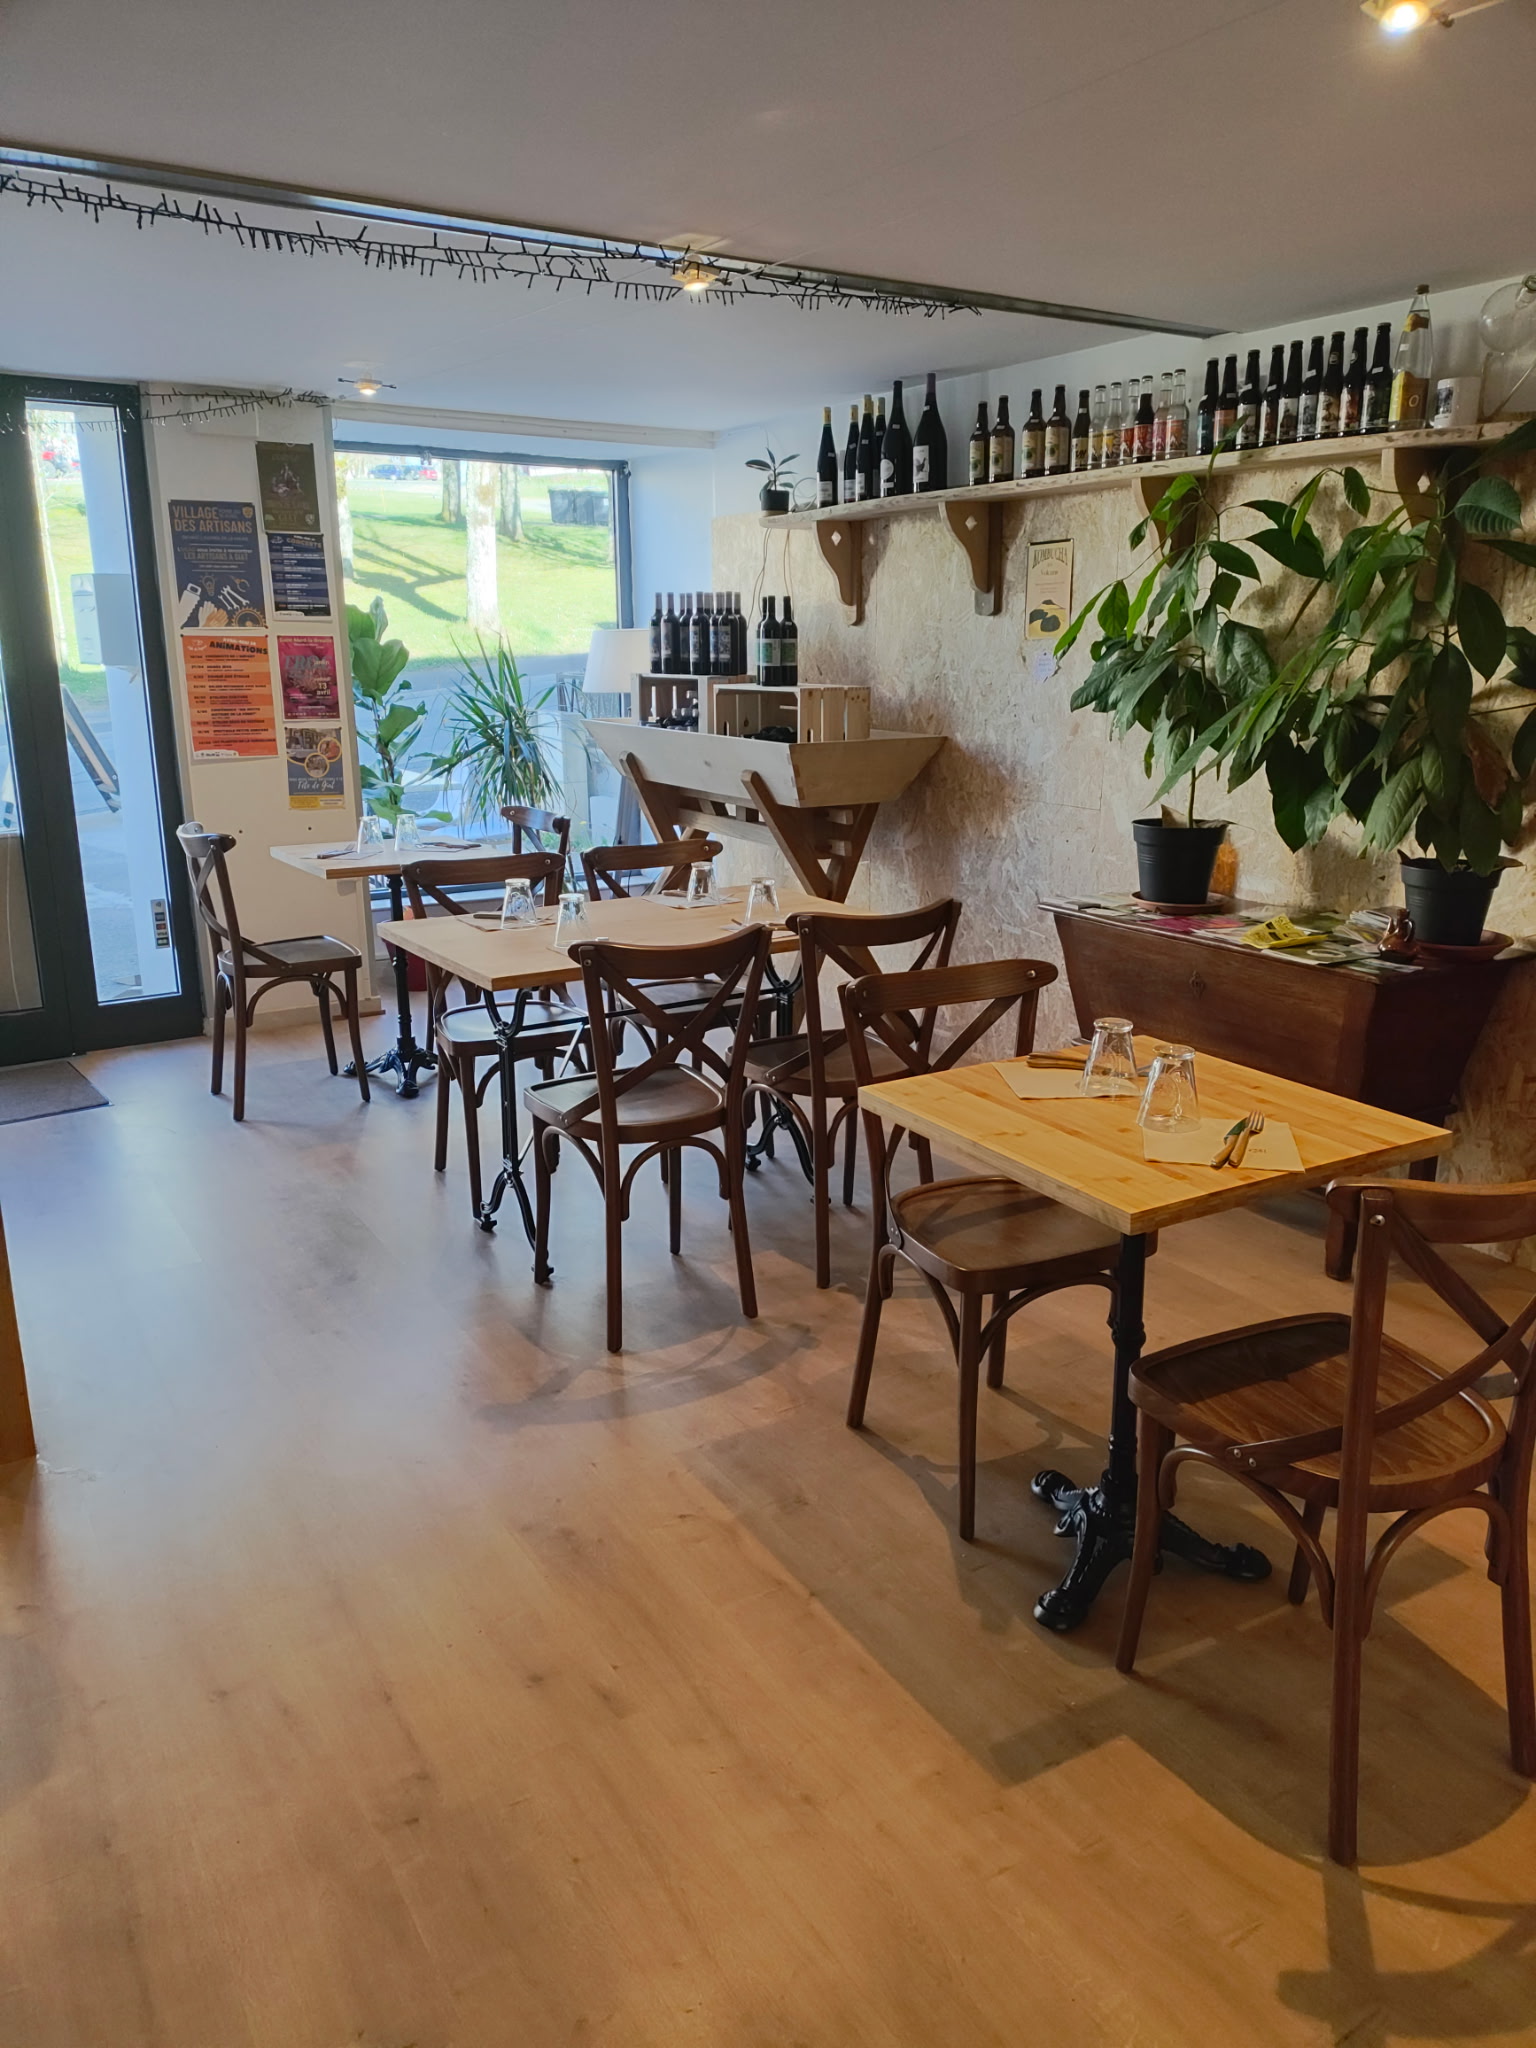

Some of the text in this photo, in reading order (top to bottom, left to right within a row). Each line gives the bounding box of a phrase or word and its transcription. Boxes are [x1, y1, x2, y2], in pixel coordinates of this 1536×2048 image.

[172, 505, 219, 520] VILLAGE
[174, 519, 253, 534] DES ARTISANS
[1032, 547, 1068, 570] KOMBUCHA
